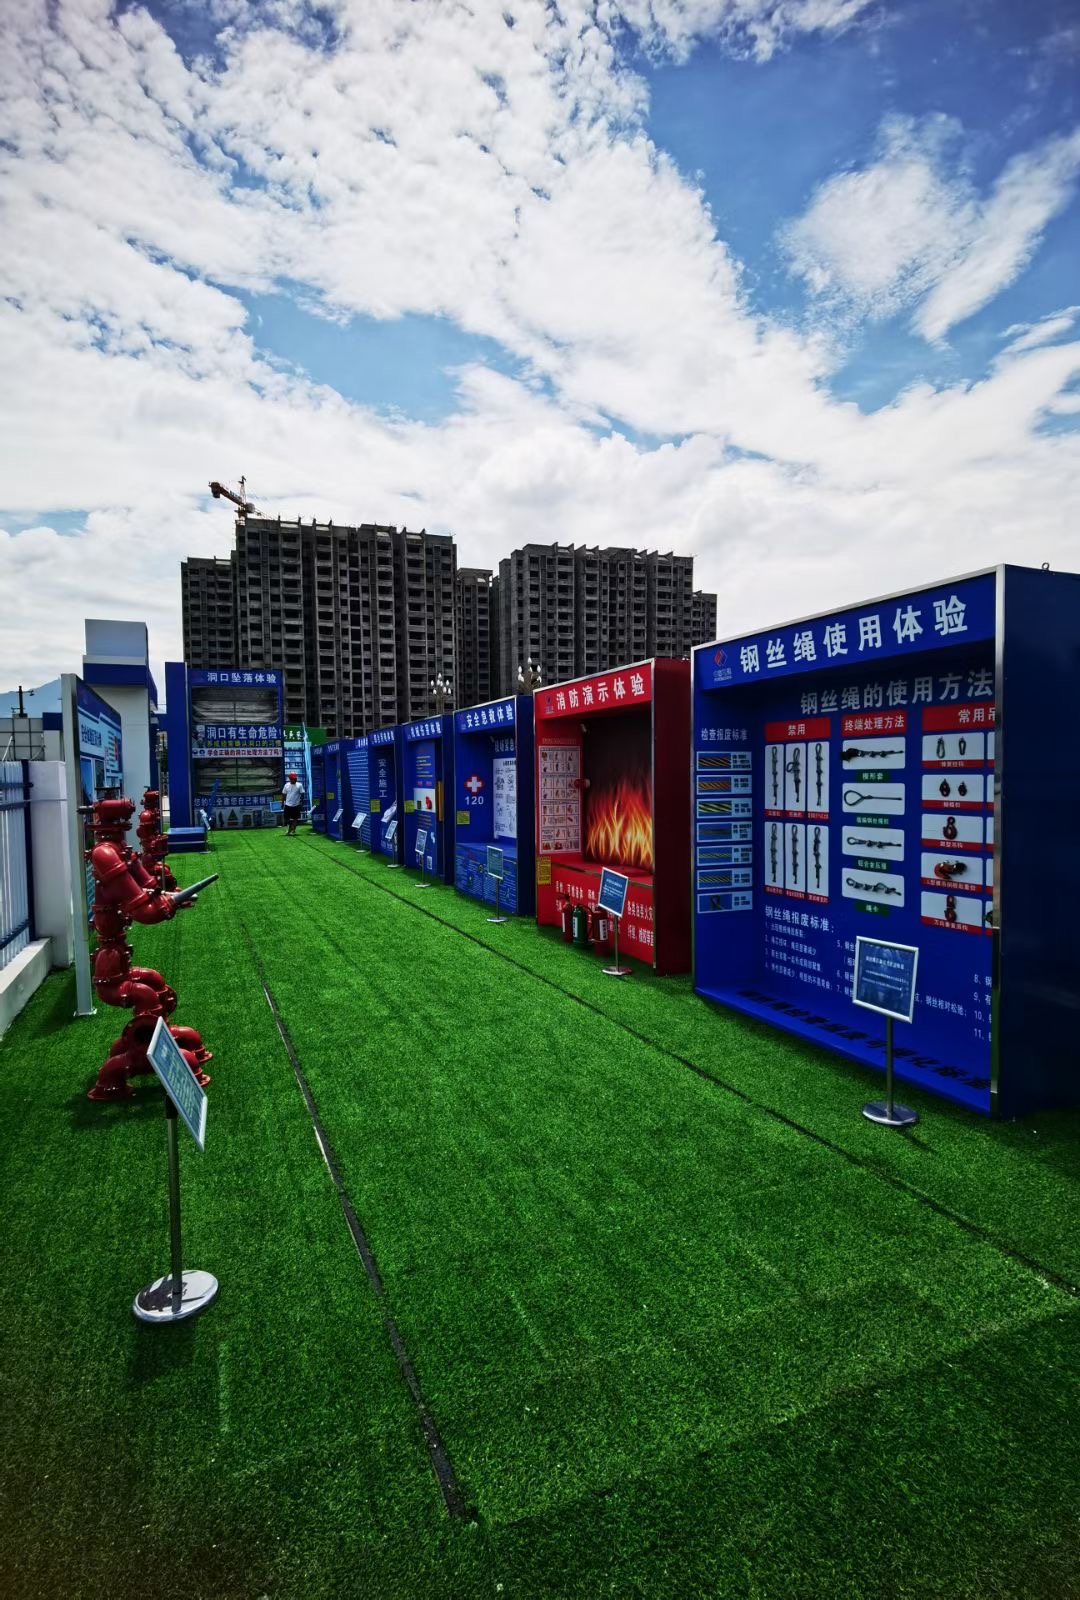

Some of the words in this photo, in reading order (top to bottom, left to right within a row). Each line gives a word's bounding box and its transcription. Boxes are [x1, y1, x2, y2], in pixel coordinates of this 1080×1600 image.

[739, 594, 968, 674] 钢丝绳使用体验
[207, 672, 277, 684] 洞口坠落体验
[556, 672, 645, 711] 消防演示体验
[801, 668, 993, 715] 钢丝绳的使用方法
[466, 704, 514, 728] 安全急救体验
[844, 714, 905, 732] 终端处理方法
[701, 728, 748, 741] 检查报废标准
[788, 723, 806, 737] 禁用
[378, 758, 388, 798] 安全施工
[465, 796, 484, 806] 120
[865, 904, 879, 913] 绳卡
